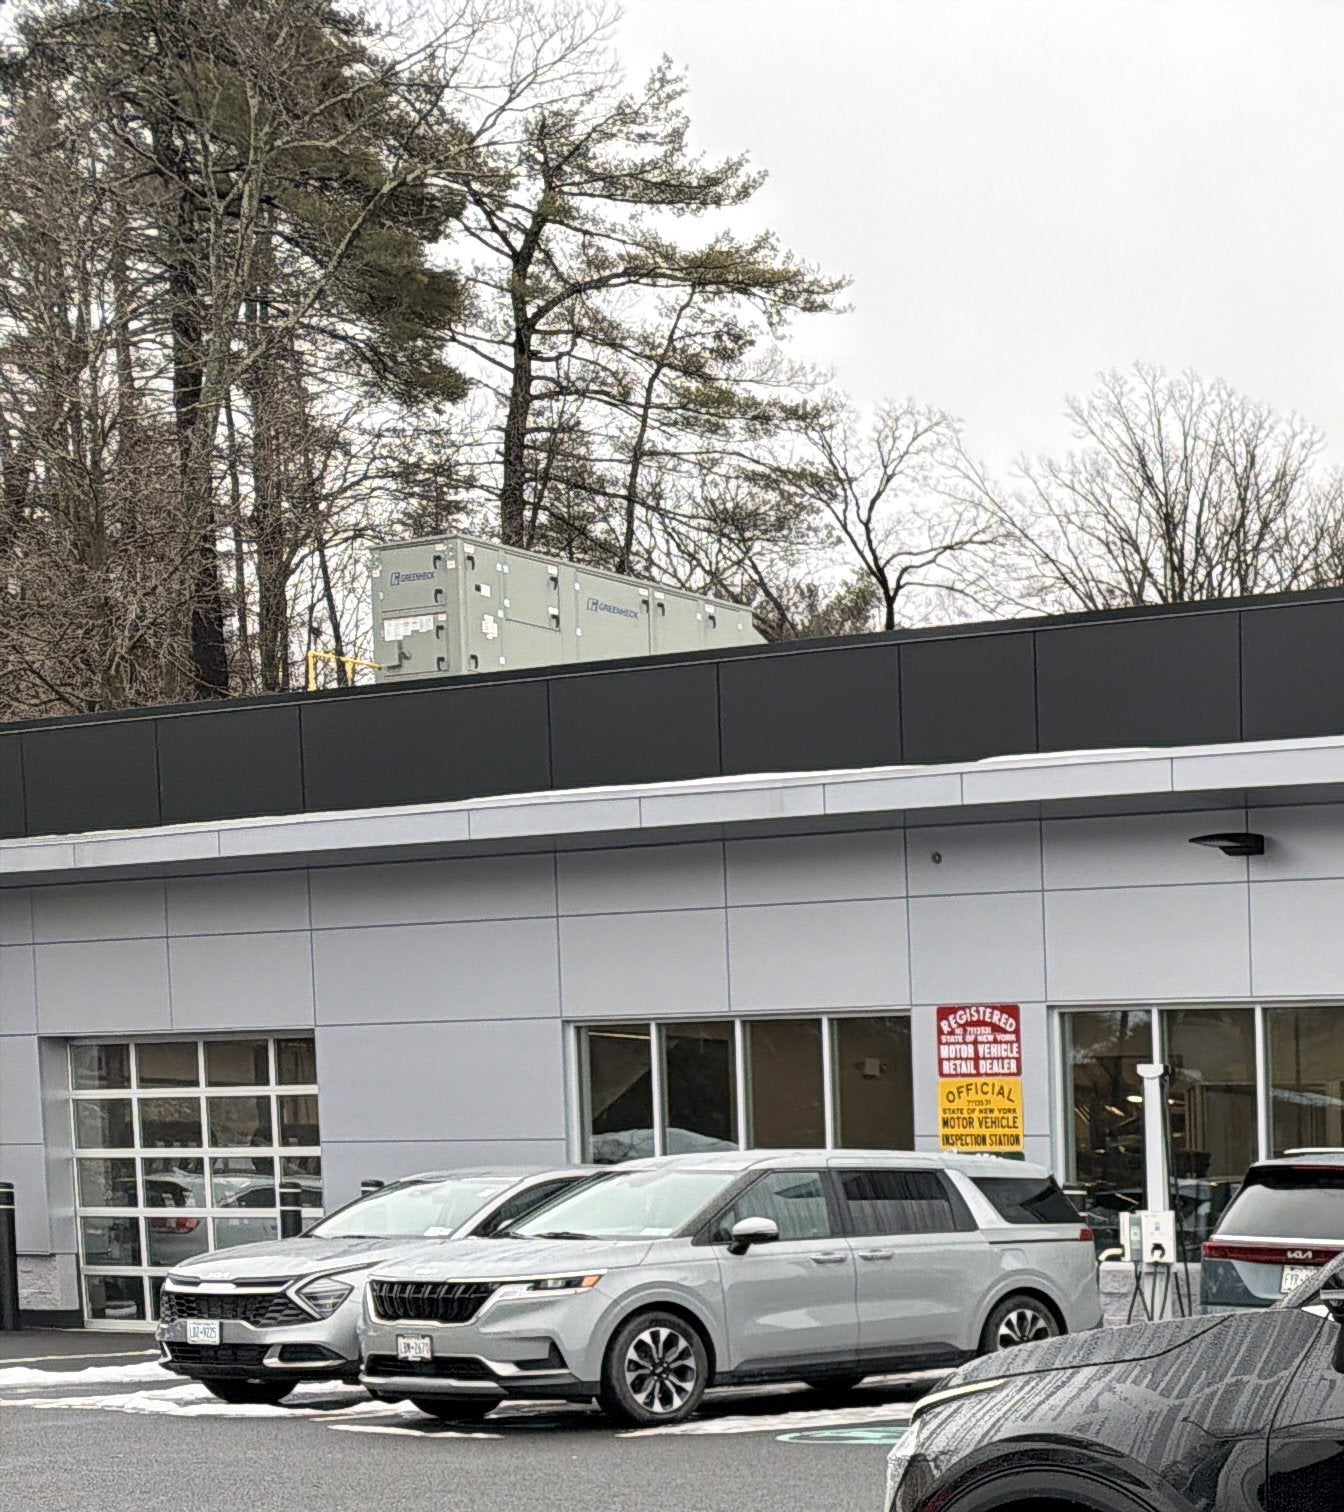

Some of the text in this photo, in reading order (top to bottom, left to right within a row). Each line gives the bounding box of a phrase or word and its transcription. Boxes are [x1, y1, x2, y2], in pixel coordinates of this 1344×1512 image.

[400, 571, 435, 583] GREENHECK
[598, 602, 639, 619] GREENHECK
[940, 1006, 1016, 1034] REGISTERED
[941, 1033, 1017, 1043] STATE OF NEW YORK
[940, 1043, 1020, 1058] MOTOR VEHICLE
[942, 1059, 1018, 1074] RETAIL DEALER
[945, 1082, 1015, 1103] OFFICIAL
[997, 1107, 1017, 1115] YORK
[942, 1116, 1019, 1129] MOTOR VEHICLE
[942, 1134, 1020, 1146] INSPECTION STATION
[1286, 1250, 1313, 1259] KIA
